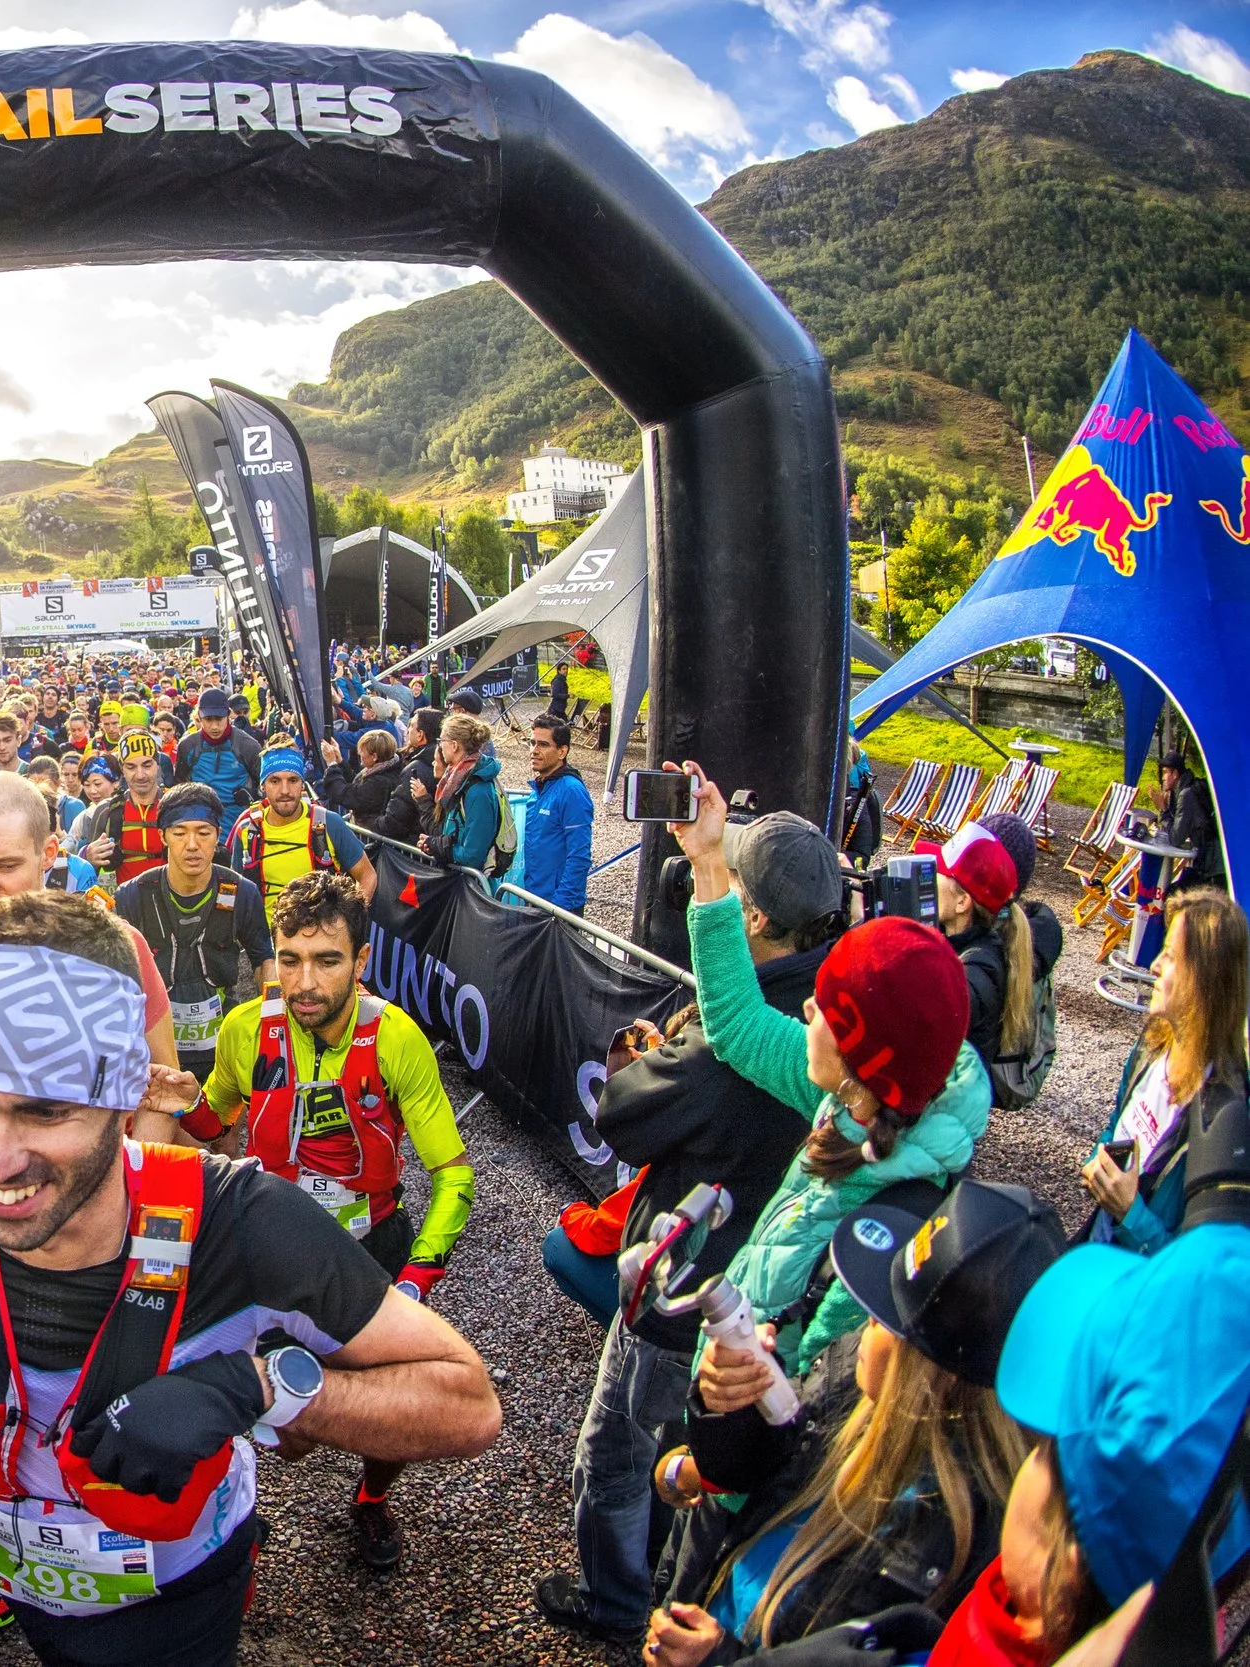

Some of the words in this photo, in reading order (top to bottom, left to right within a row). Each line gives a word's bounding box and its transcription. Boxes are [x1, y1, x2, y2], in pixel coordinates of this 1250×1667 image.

[1084, 403, 1153, 446] Bull
[482, 679, 514, 697] SUUNTO
[361, 920, 490, 1071] UUNTO
[174, 1022, 210, 1040] 757
[101, 1532, 142, 1543] Scotlan
[38, 1556, 77, 1569] SKYRACE
[8, 1553, 101, 1602] 298
[21, 1586, 64, 1610] Nelson
